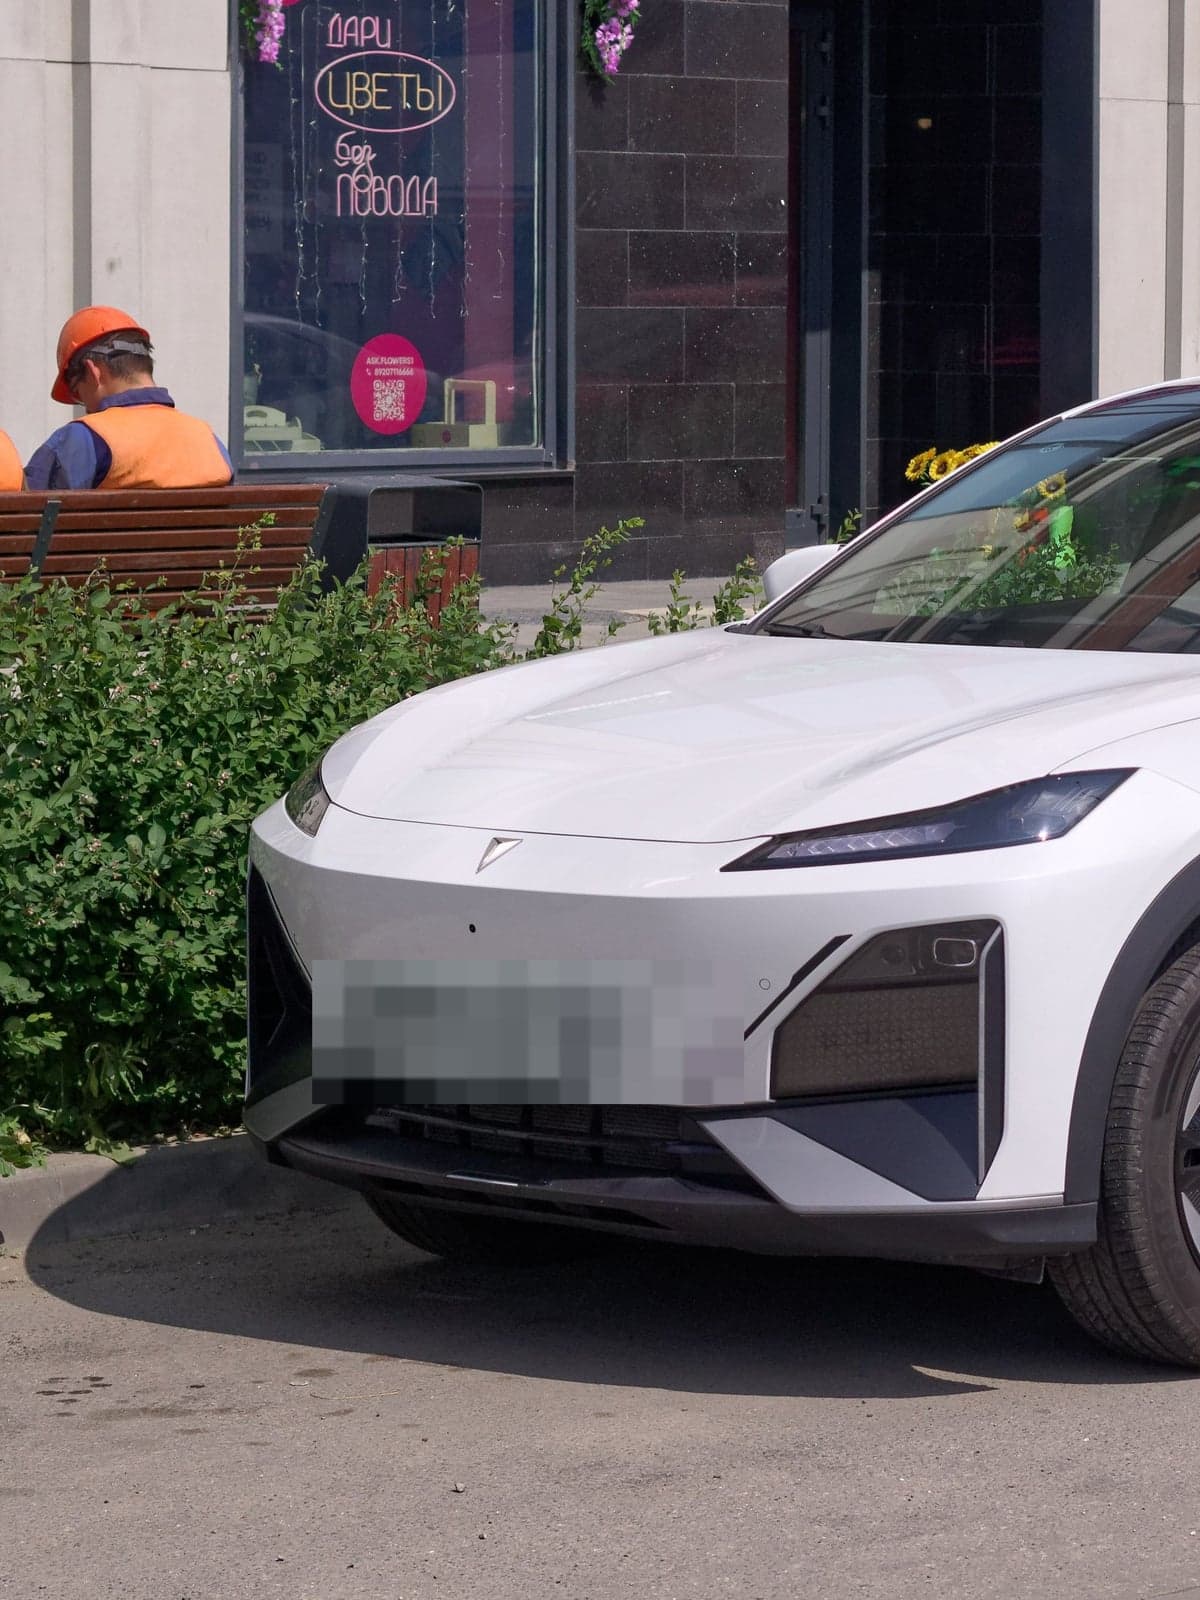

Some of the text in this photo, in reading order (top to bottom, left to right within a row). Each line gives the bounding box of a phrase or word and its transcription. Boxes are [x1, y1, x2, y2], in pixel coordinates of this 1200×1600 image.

[325, 13, 391, 48] ДАРИ
[328, 71, 442, 115] ЦВЕТЫ
[336, 173, 438, 217] ПОВОДА
